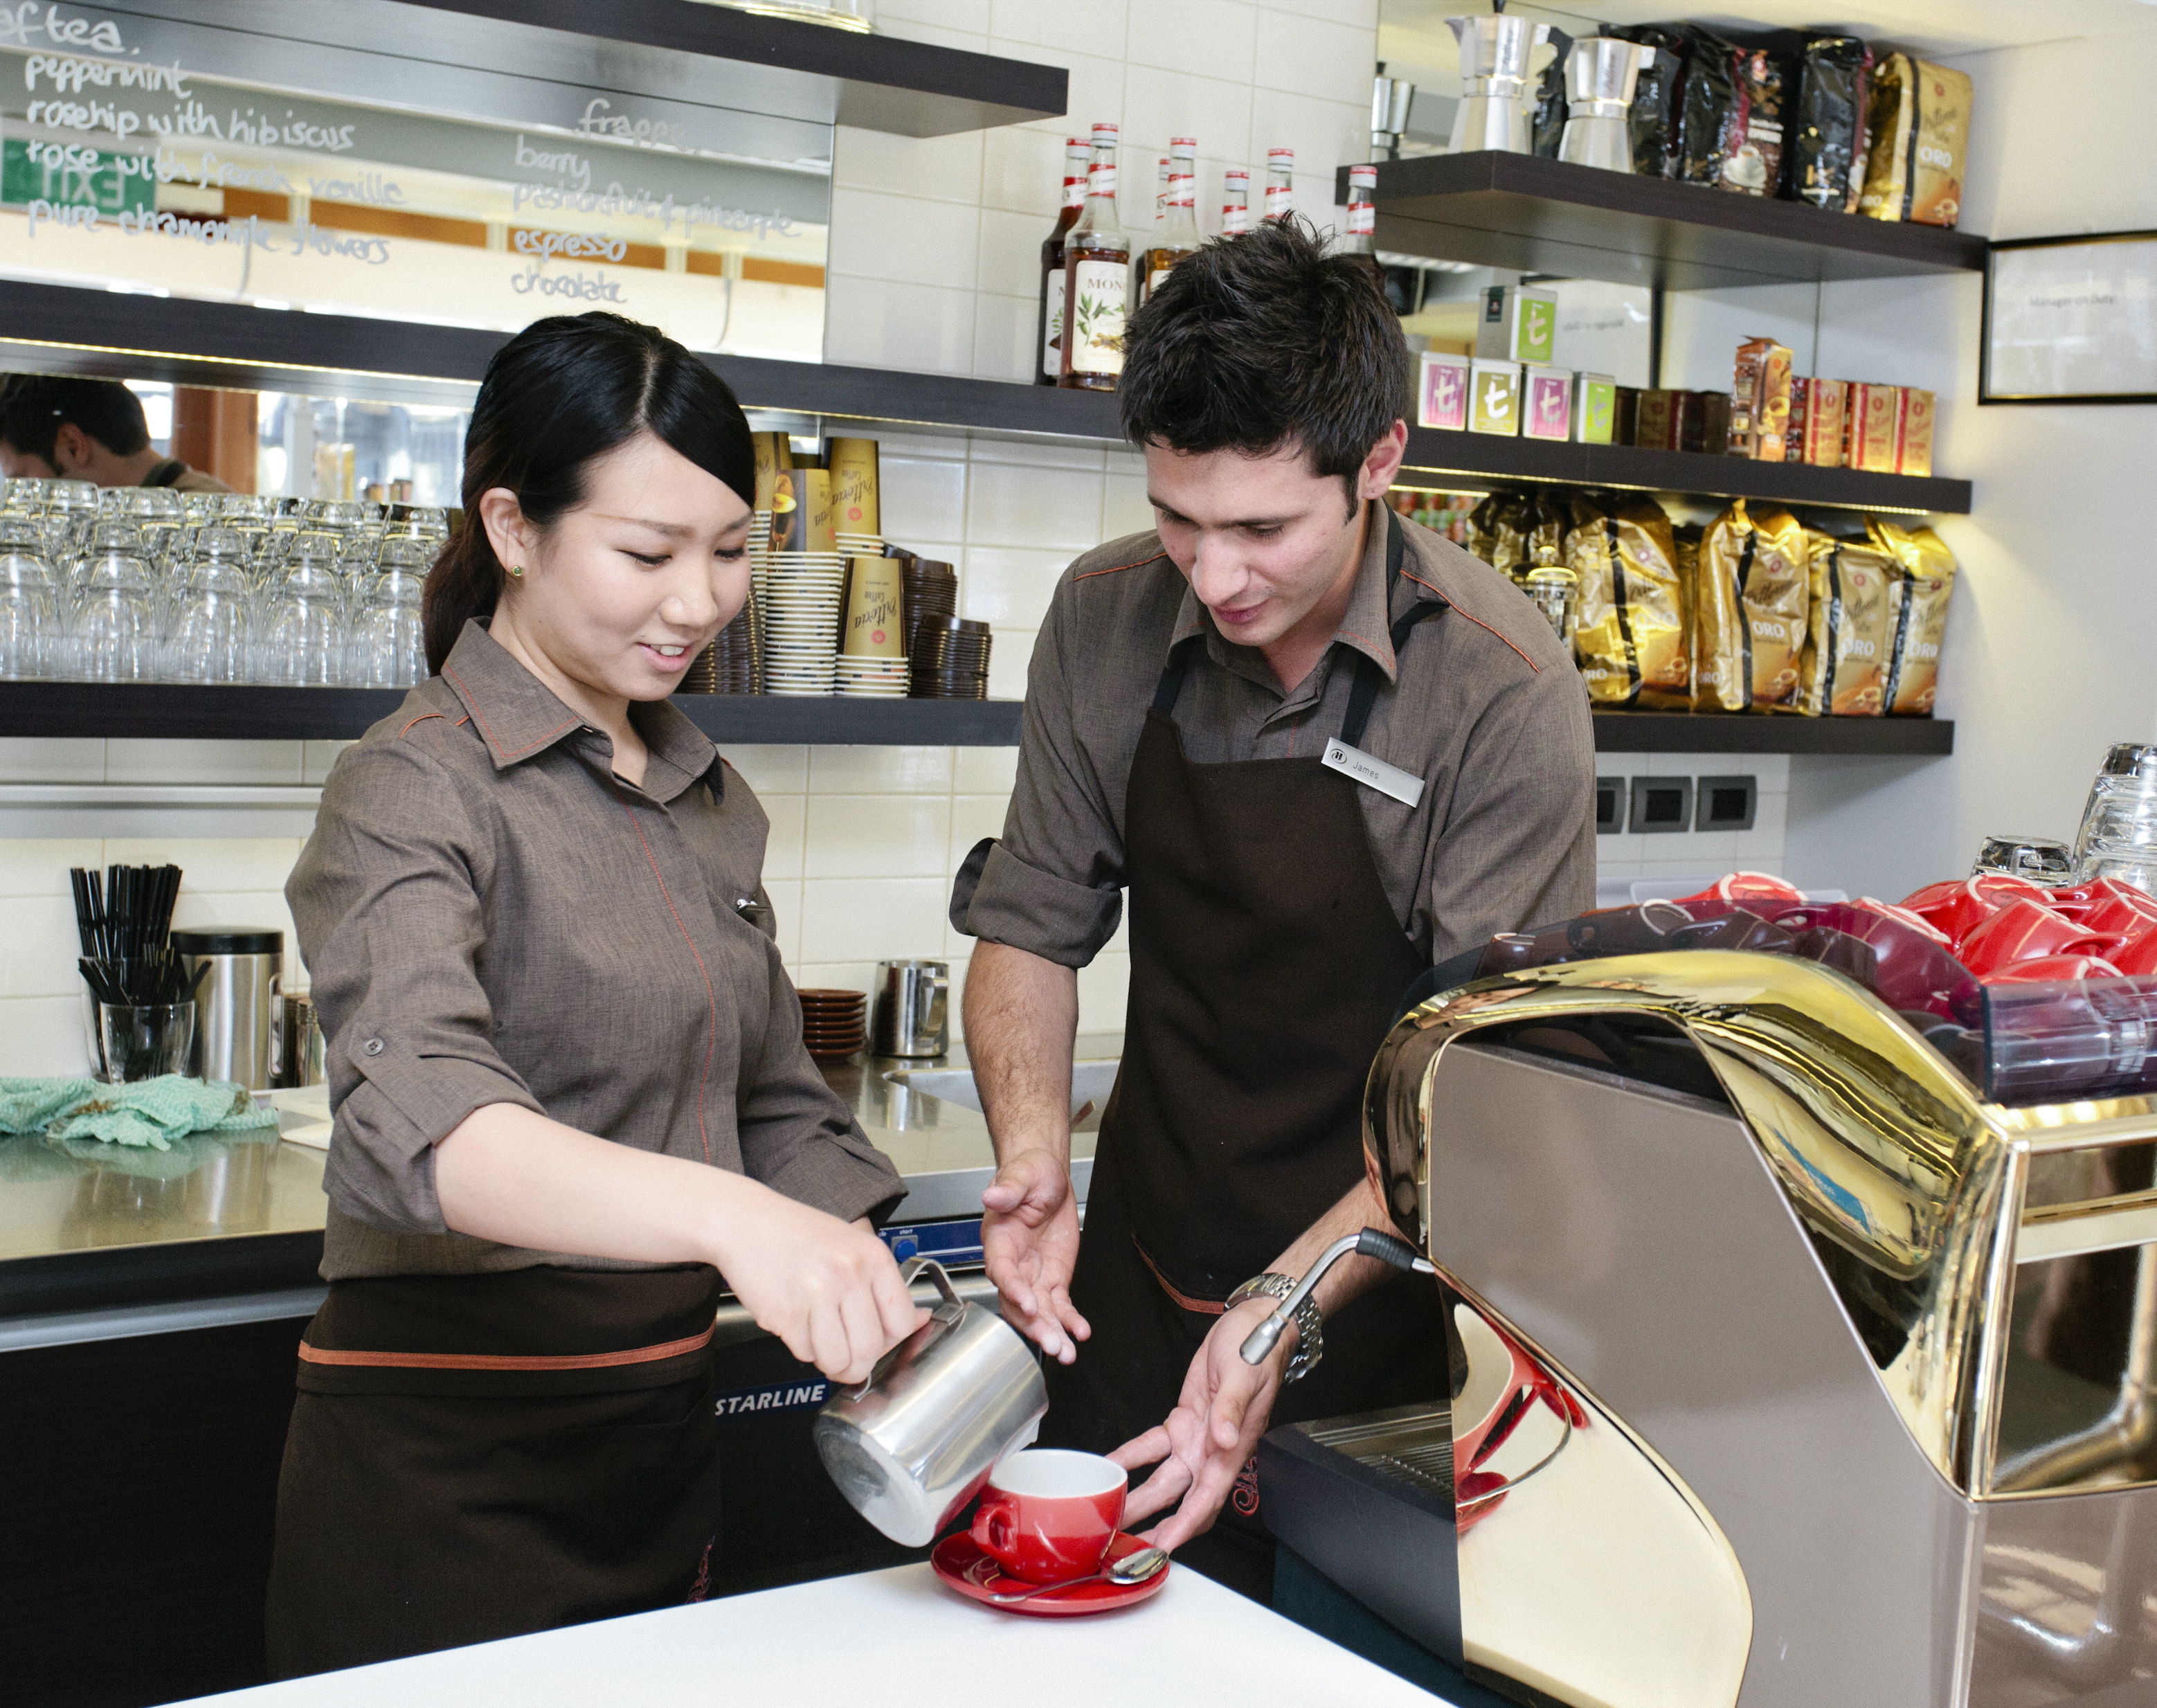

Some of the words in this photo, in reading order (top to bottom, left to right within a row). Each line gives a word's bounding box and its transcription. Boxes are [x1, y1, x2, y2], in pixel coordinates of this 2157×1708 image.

[25, 55, 192, 99] peppermint
[27, 99, 140, 140] rosehip
[147, 100, 223, 138] with
[229, 107, 355, 152] hibiscus
[26, 139, 105, 174] rose
[115, 146, 193, 183] with
[515, 134, 591, 193] berry
[28, 199, 101, 239] pure
[291, 215, 390, 264] flowers
[514, 228, 627, 262] espresso
[1752, 620, 1785, 638] ORO
[1841, 637, 1875, 656] ORO
[1353, 761, 1380, 780] James
[715, 1384, 826, 1417] STARLINE
